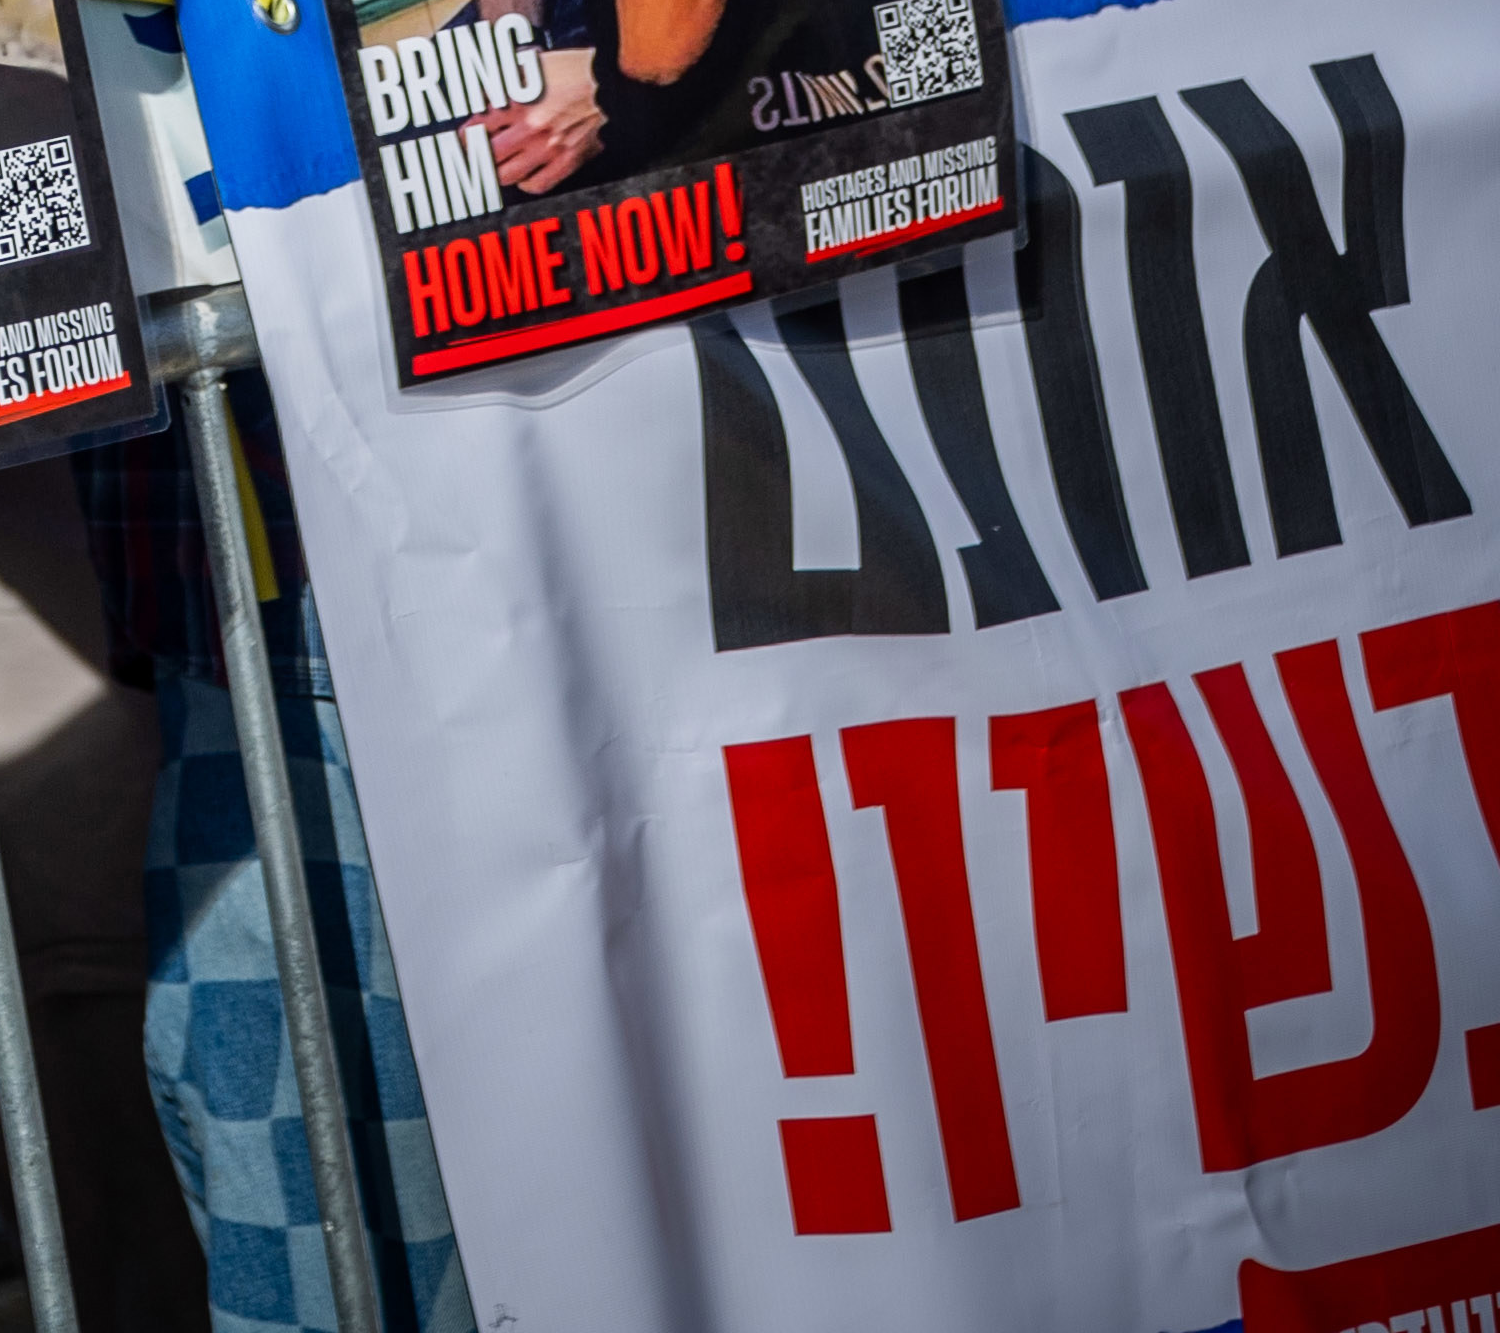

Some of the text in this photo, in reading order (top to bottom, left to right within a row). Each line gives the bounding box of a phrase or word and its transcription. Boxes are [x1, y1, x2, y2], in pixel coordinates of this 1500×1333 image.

[358, 13, 543, 136] BRING
[380, 125, 502, 234] HIM
[801, 136, 997, 212] HOSTAGES AND MISSING
[804, 165, 999, 254] FAMILIES FORUM
[403, 162, 747, 338] HOME NOW!
[31, 336, 124, 399] FORUM
[35, 303, 115, 349] MISSING
